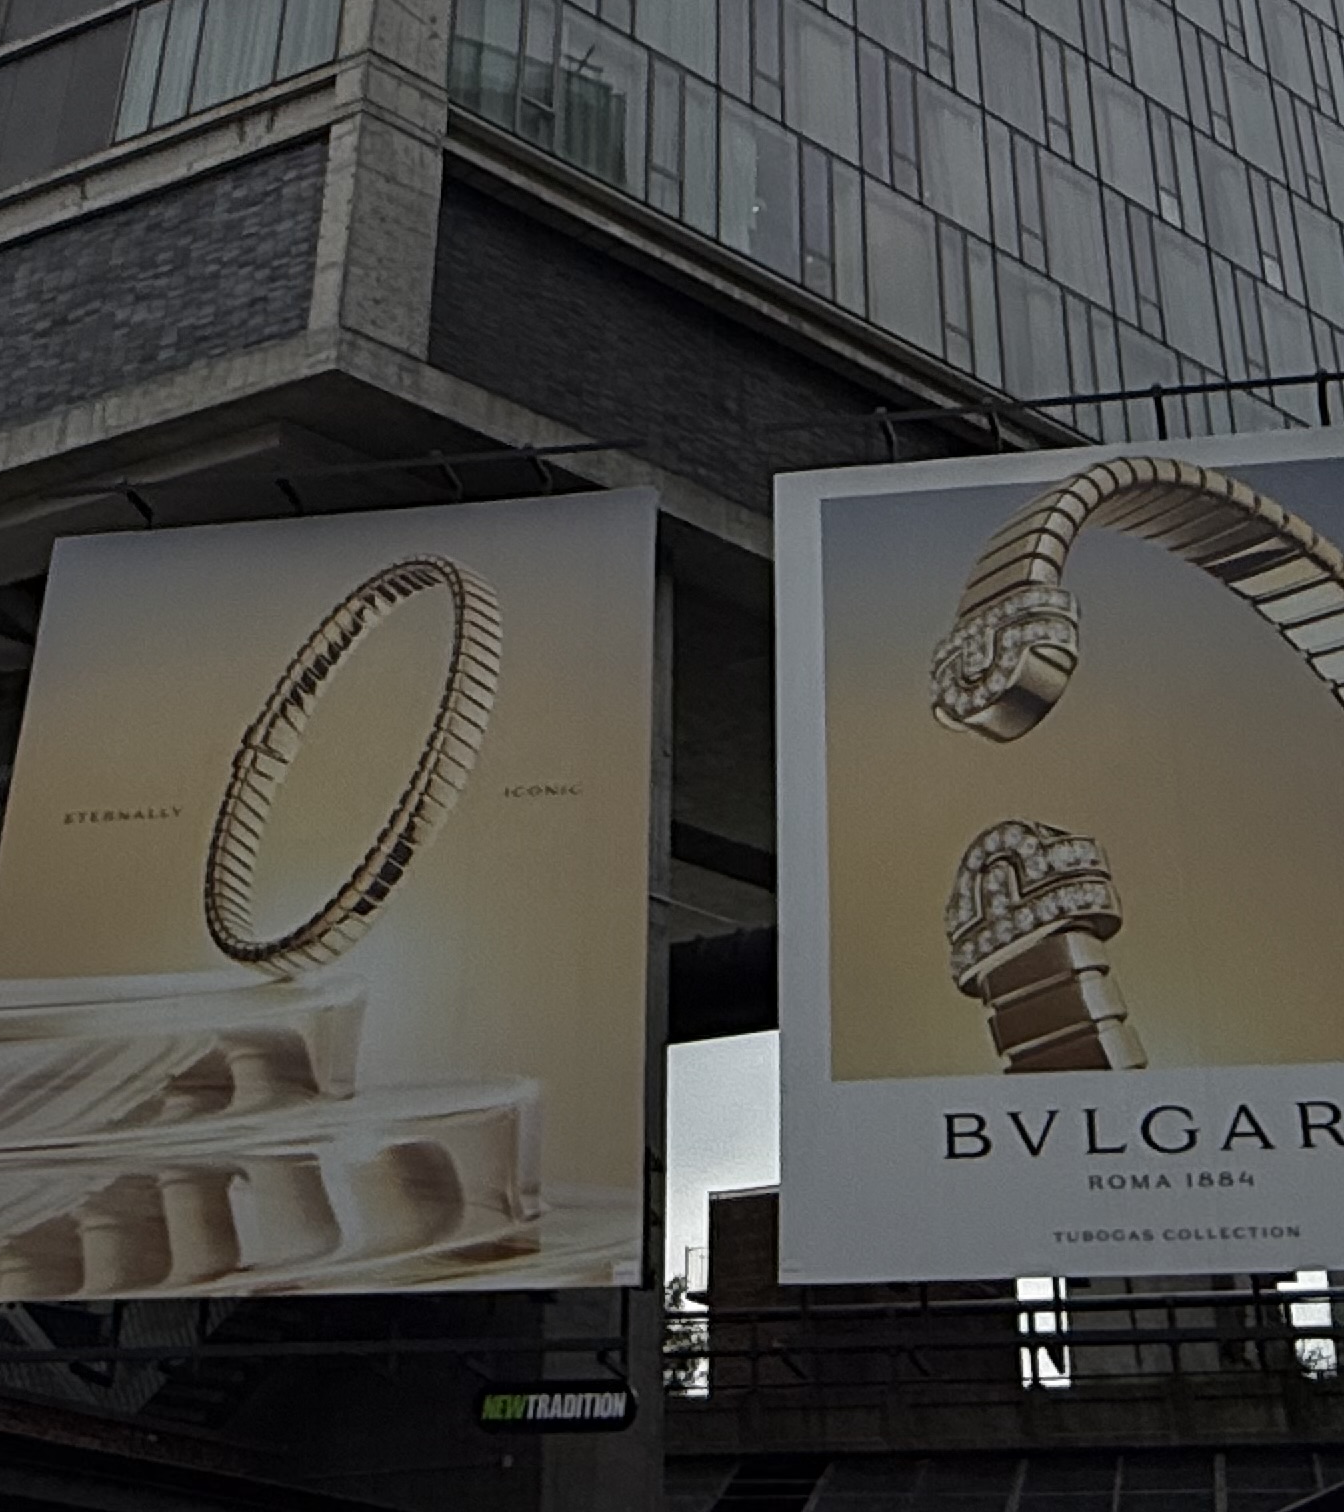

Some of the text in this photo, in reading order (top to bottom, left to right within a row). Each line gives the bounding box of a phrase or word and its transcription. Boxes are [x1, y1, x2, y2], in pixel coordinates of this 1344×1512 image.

[503, 782, 583, 798] ICONIC
[63, 805, 182, 825] ETERNALLY
[1088, 1170, 1255, 1191] ROMA 1884
[1052, 1225, 1301, 1244] TUBOGAS COLLECTION
